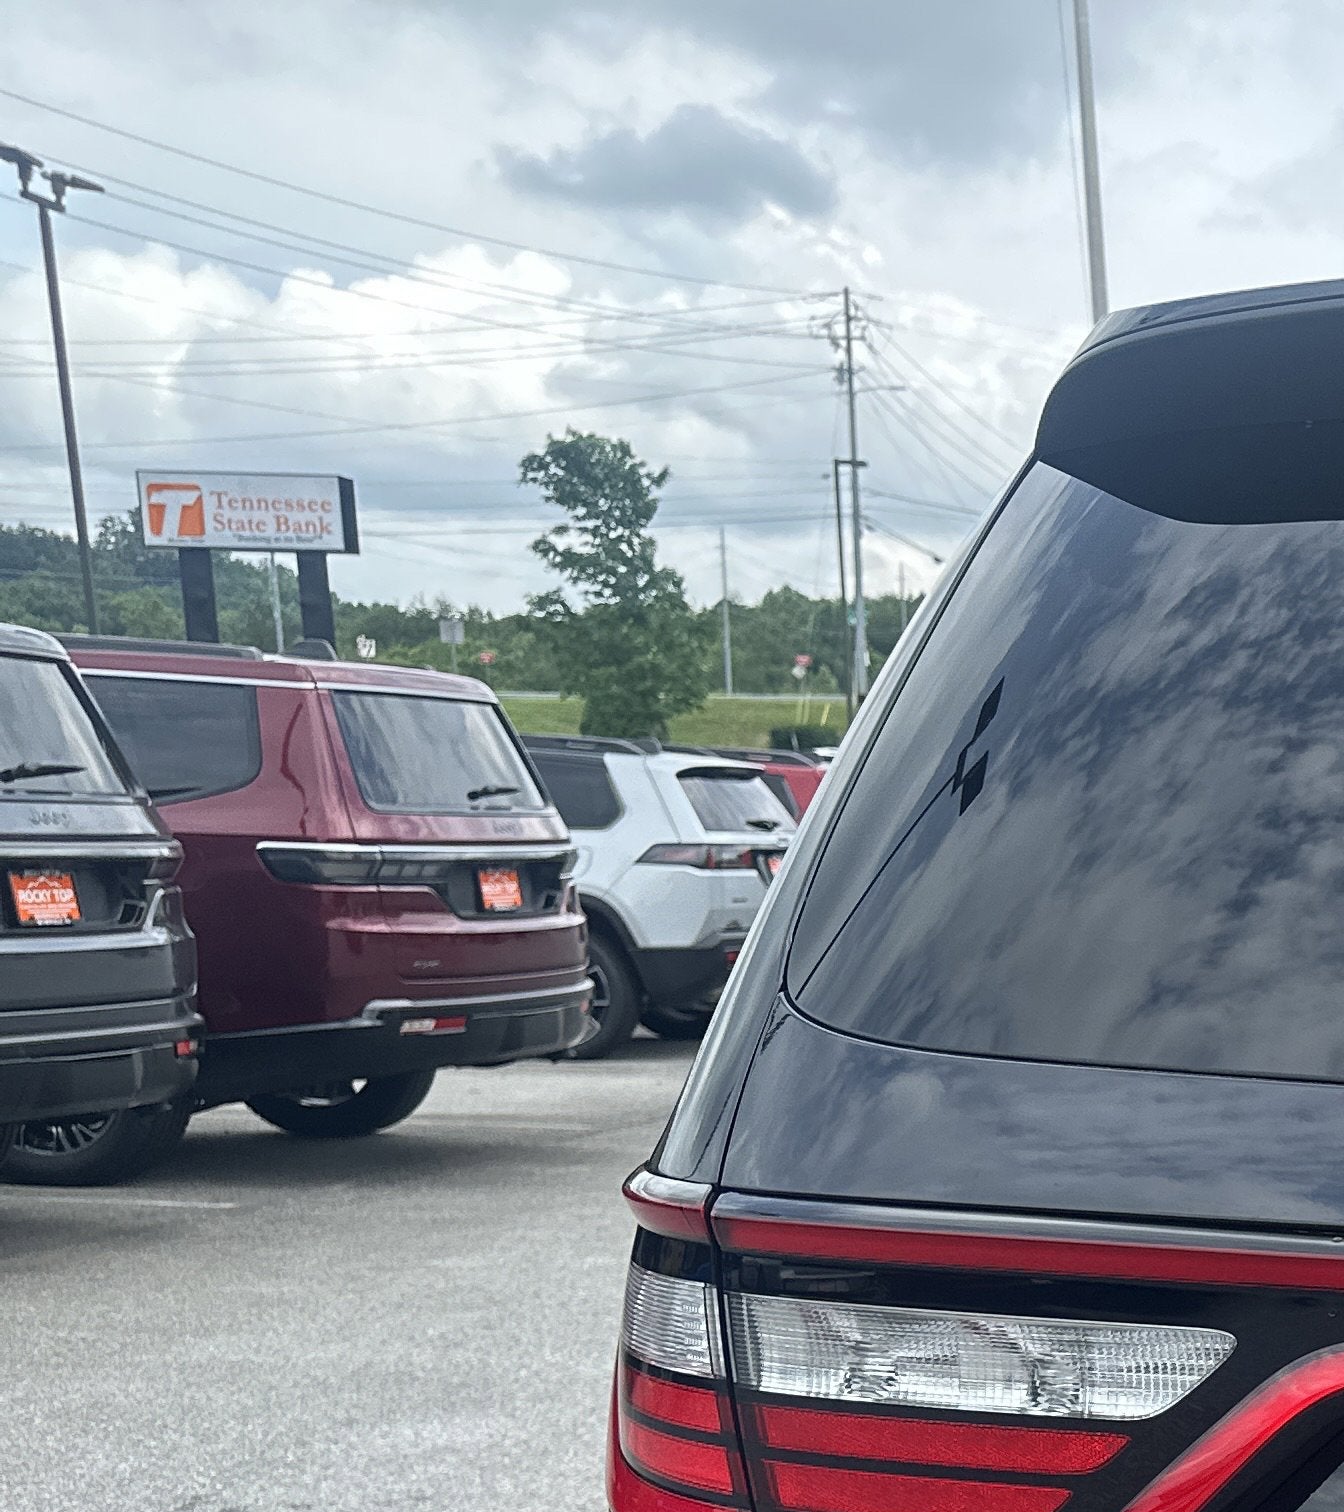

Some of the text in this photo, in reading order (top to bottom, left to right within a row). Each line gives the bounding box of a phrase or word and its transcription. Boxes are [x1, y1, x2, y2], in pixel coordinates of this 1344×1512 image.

[210, 490, 333, 514] Tennessee
[212, 513, 333, 535] State Bank
